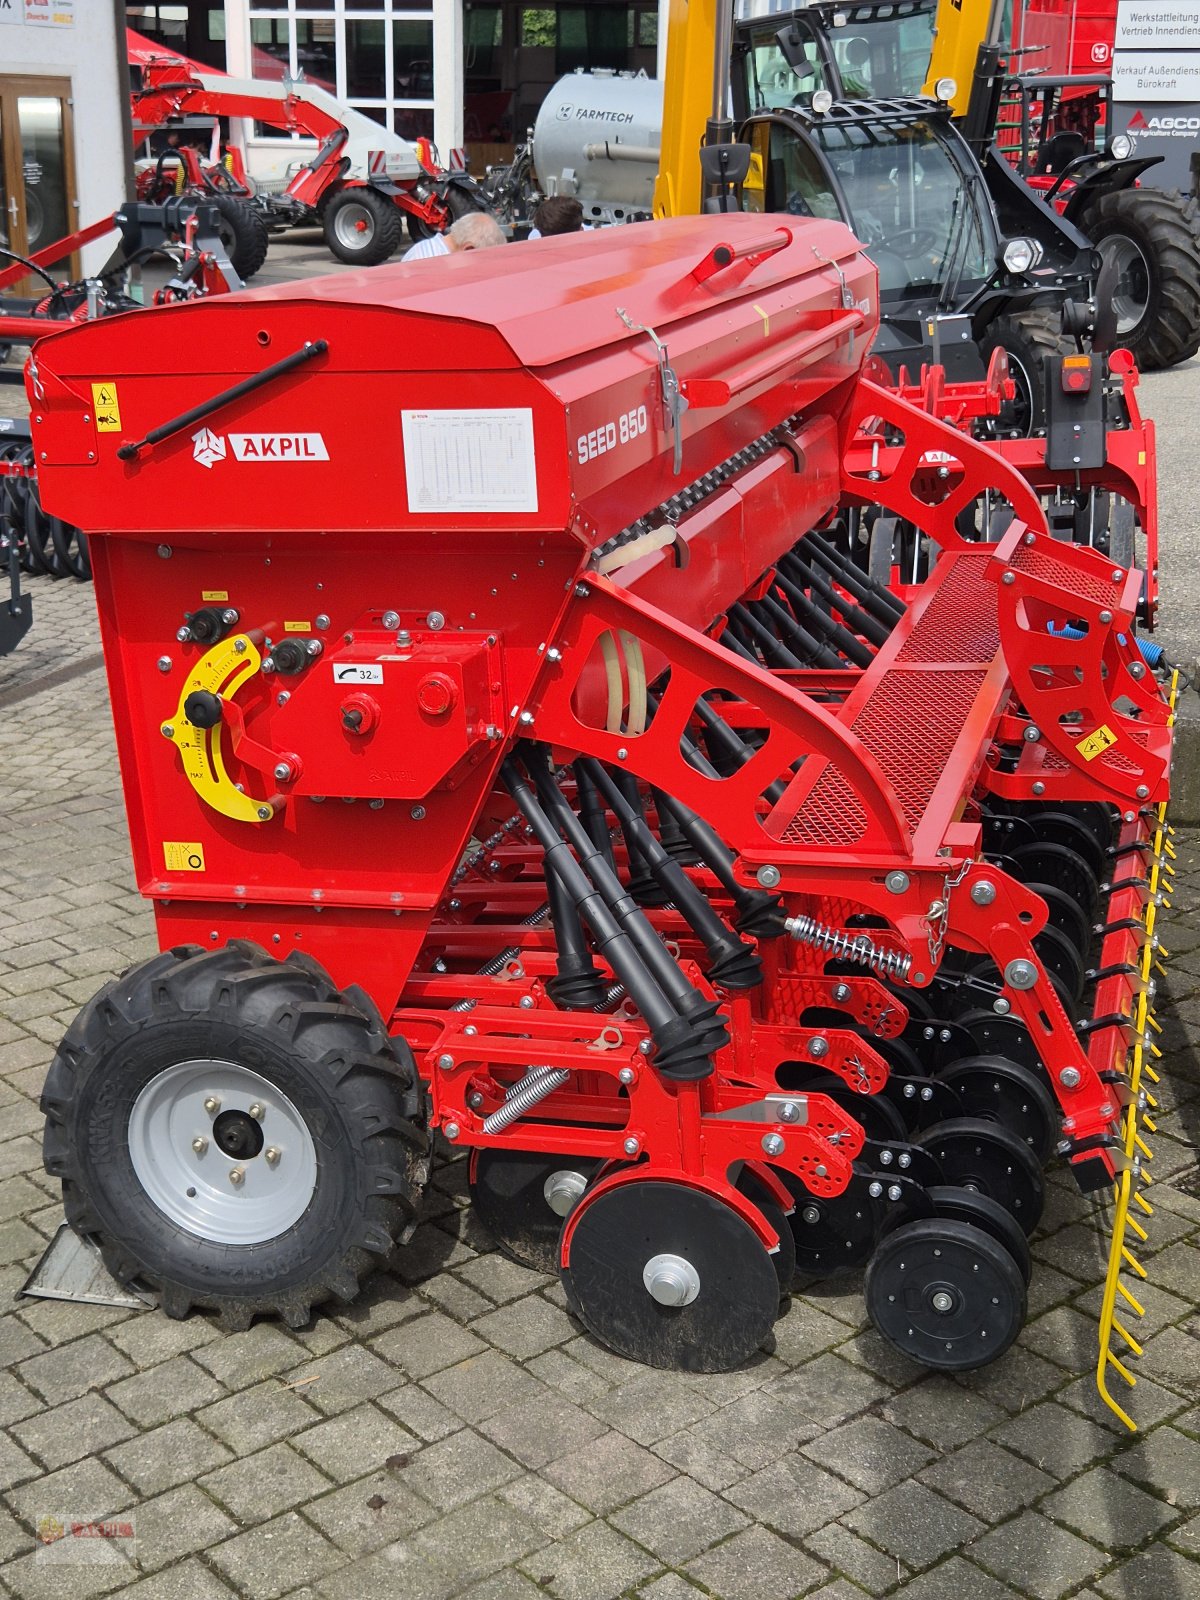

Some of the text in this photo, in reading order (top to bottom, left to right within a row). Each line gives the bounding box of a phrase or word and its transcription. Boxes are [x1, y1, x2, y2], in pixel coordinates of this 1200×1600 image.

[1130, 13, 1199, 24] Werkstattleitung
[1121, 27, 1200, 36] Vertrieb Innendiens
[1116, 66, 1147, 76] Verkauf
[1137, 79, 1177, 89] Bürokraft
[576, 108, 634, 124] FARMTECH
[1148, 117, 1200, 129] AGCO
[1126, 129, 1199, 138] Your Agriculture Company
[577, 404, 647, 465] SEED 850
[243, 437, 316, 457] AKPIL
